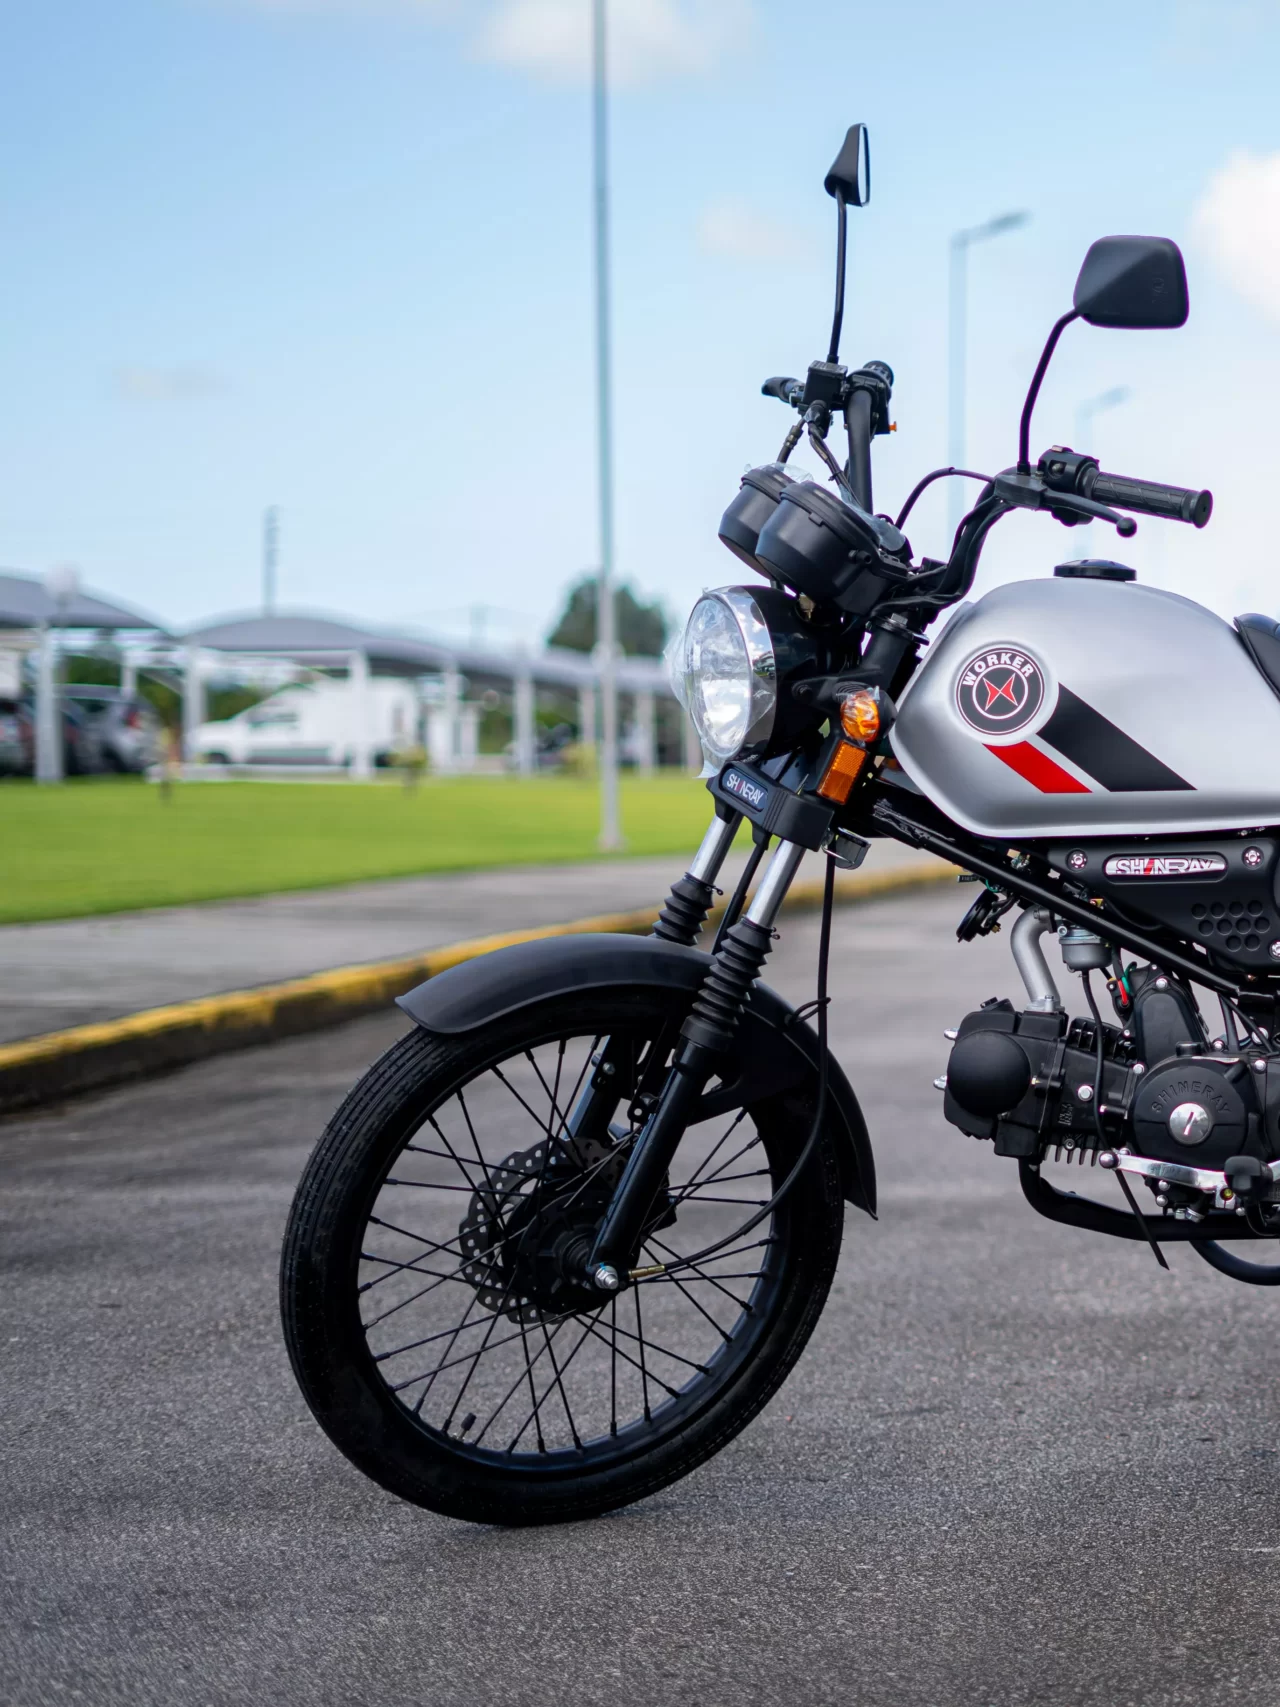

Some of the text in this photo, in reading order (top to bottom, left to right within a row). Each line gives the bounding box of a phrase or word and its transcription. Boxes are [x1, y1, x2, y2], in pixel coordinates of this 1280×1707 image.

[962, 652, 1034, 686] WORKER
[726, 773, 765, 805] SHINERAY
[1116, 858, 1213, 876] SHINERAY
[1151, 1080, 1232, 1113] SHINERAY
